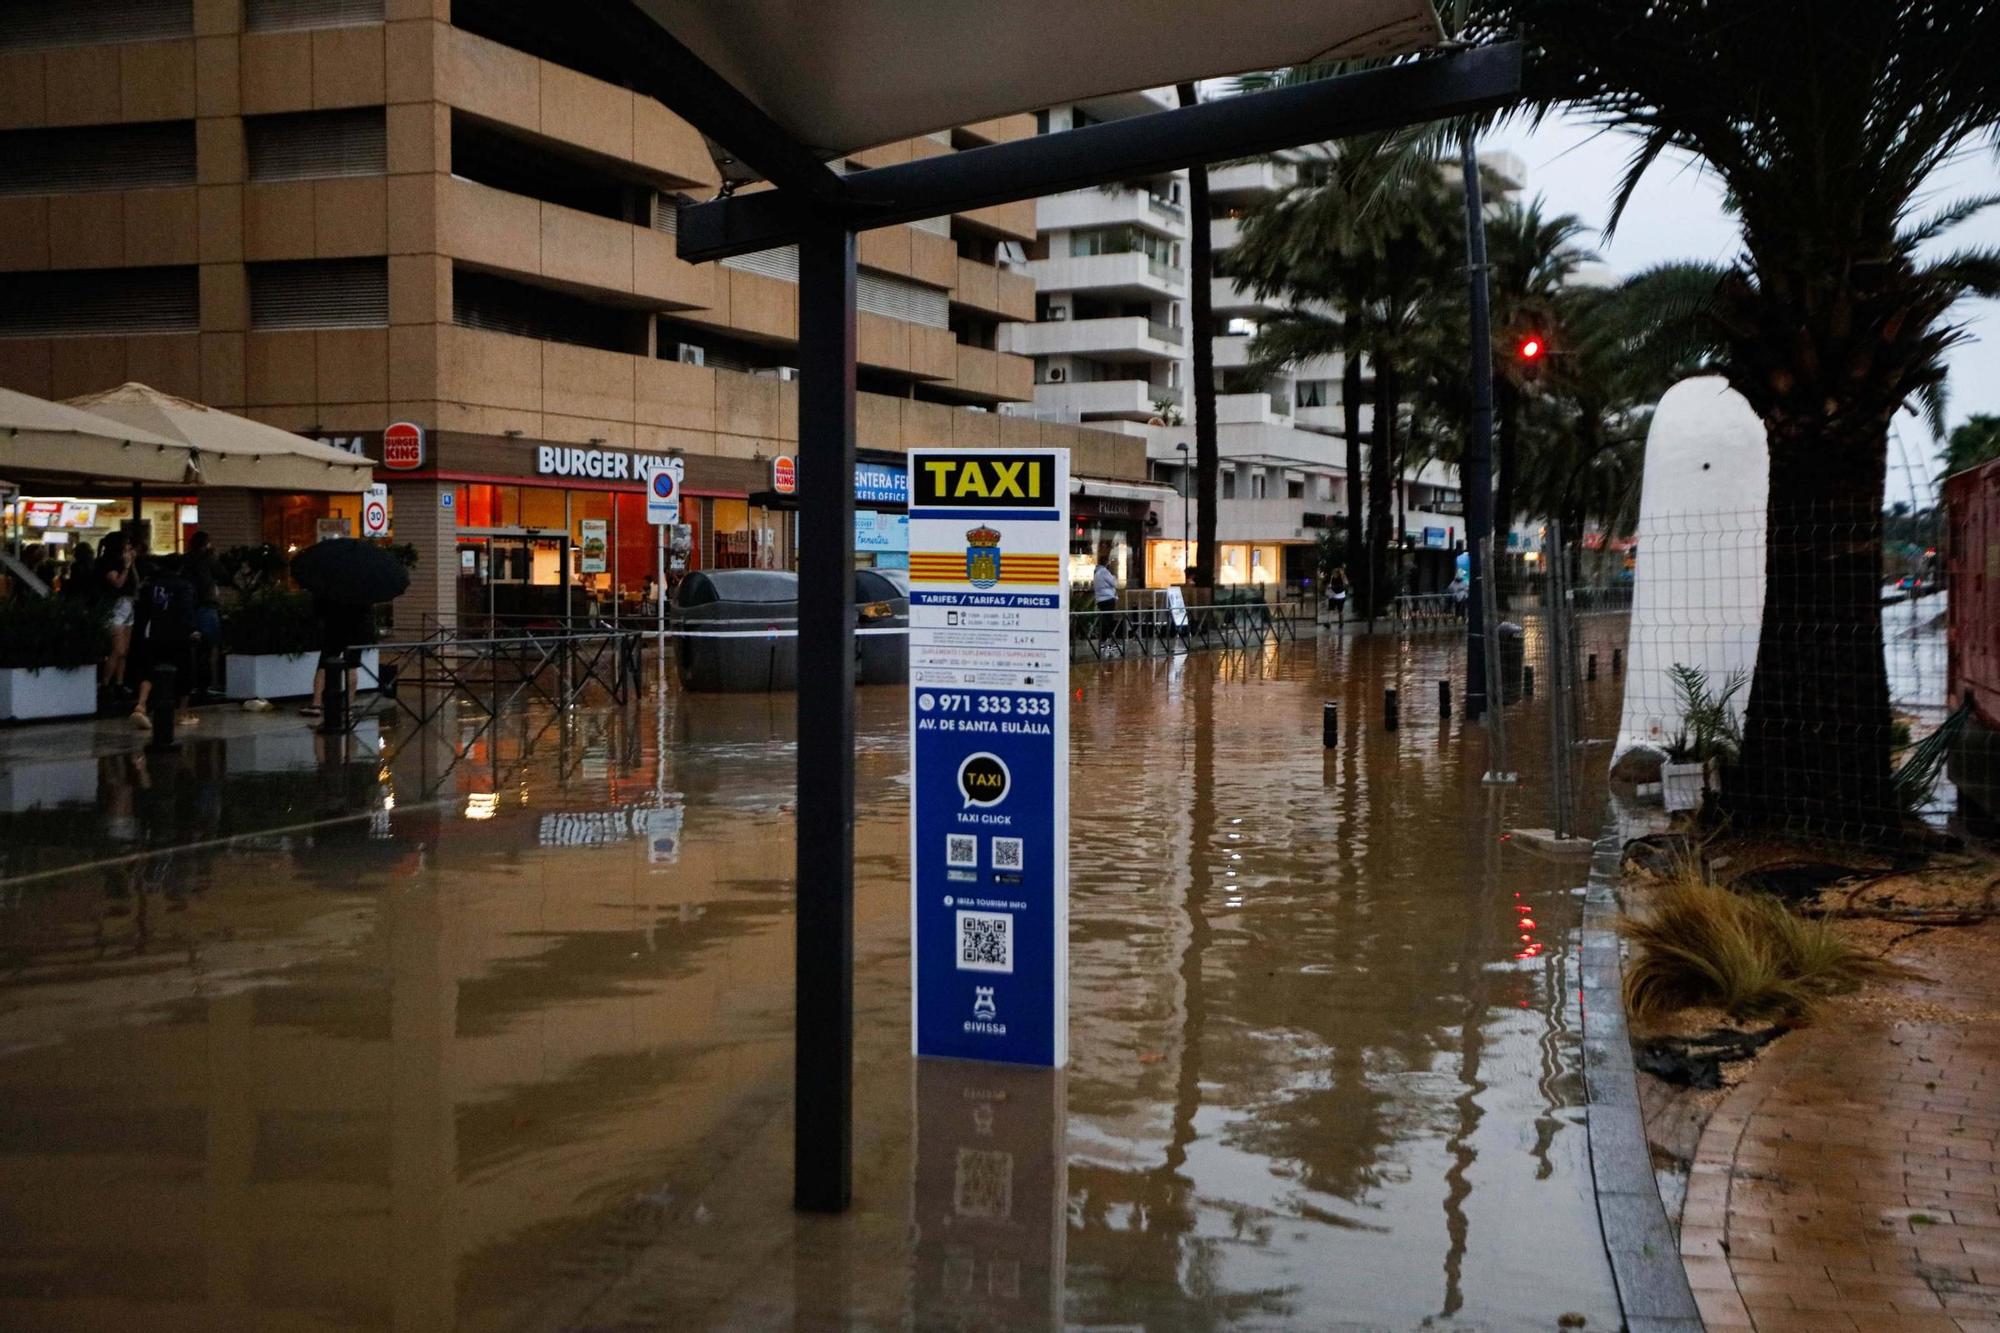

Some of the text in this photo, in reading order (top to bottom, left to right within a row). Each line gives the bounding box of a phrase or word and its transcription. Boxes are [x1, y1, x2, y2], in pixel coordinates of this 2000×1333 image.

[386, 438, 419, 446] BURGER
[386, 447, 419, 459] KING
[538, 445, 628, 479] BURGER
[776, 475, 794, 485] KING
[925, 461, 1040, 498] TAXI
[370, 511, 381, 521] 30
[921, 594, 957, 604] TARIFES
[969, 595, 1005, 605] TARIFAS
[1017, 597, 1050, 606] PRICES
[939, 694, 1050, 715] 971 333 333
[919, 718, 1051, 735] AV. DE SANTA EULÀLIA
[967, 772, 1001, 786] TAXI
[957, 813, 1011, 824] TAXI CLICK
[957, 897, 1027, 909] IBIZA TOURISM INFO
[964, 1020, 1006, 1034] eivissa
